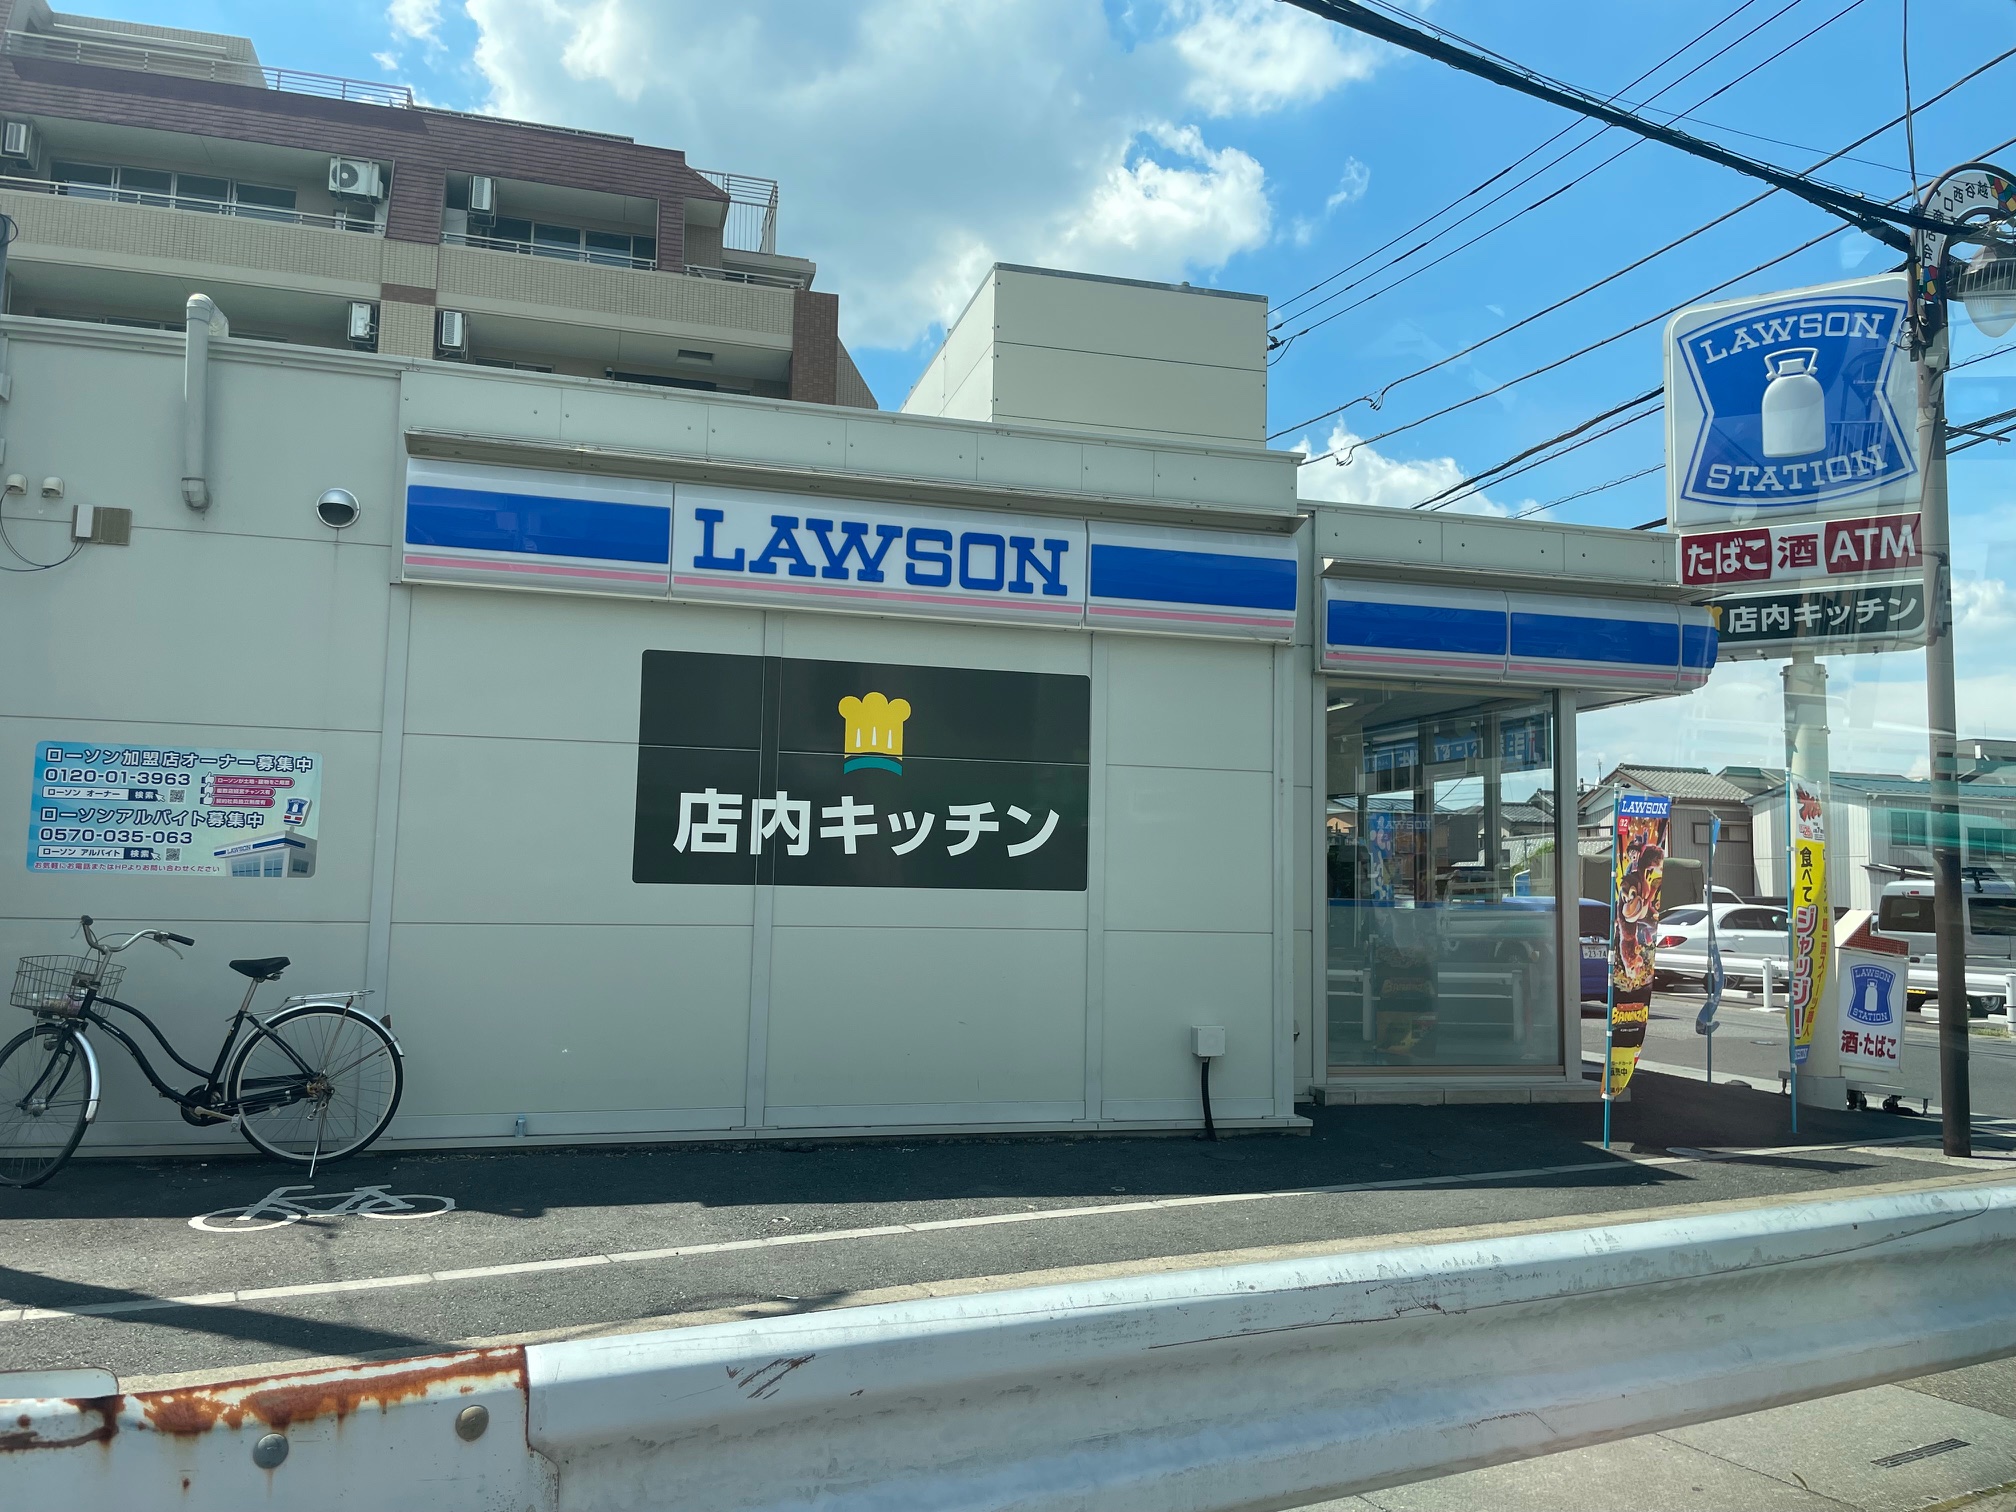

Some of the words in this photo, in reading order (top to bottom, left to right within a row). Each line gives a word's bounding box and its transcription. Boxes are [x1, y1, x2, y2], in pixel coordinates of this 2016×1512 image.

[1700, 312, 1885, 365] LAWSON
[1706, 444, 1889, 492] STATION
[693, 508, 1069, 597] LAWSON
[1687, 537, 1769, 577] たばこ
[1777, 532, 1819, 569] 酒
[1829, 524, 1917, 564] ATM
[1728, 597, 1917, 634] 店内キッチン
[46, 748, 313, 773] ローソン加盟店オーナー募集中
[45, 768, 190, 786] 0120-01-3963
[47, 788, 81, 796] ローソン
[86, 789, 121, 797] オーナー
[41, 807, 264, 829] ローソンアルバイト募集中
[1621, 800, 1668, 815] LAWSON
[40, 827, 193, 844] 0570-035-063
[673, 788, 1060, 858] 店内キッチン
[42, 848, 76, 856] ローソン
[80, 848, 121, 857] アルバイト
[1800, 846, 1813, 903] 食べて
[1855, 968, 1891, 983] LAWSON
[1852, 1008, 1888, 1022] STATION
[1840, 1030, 1897, 1060] 酒・たばこ
